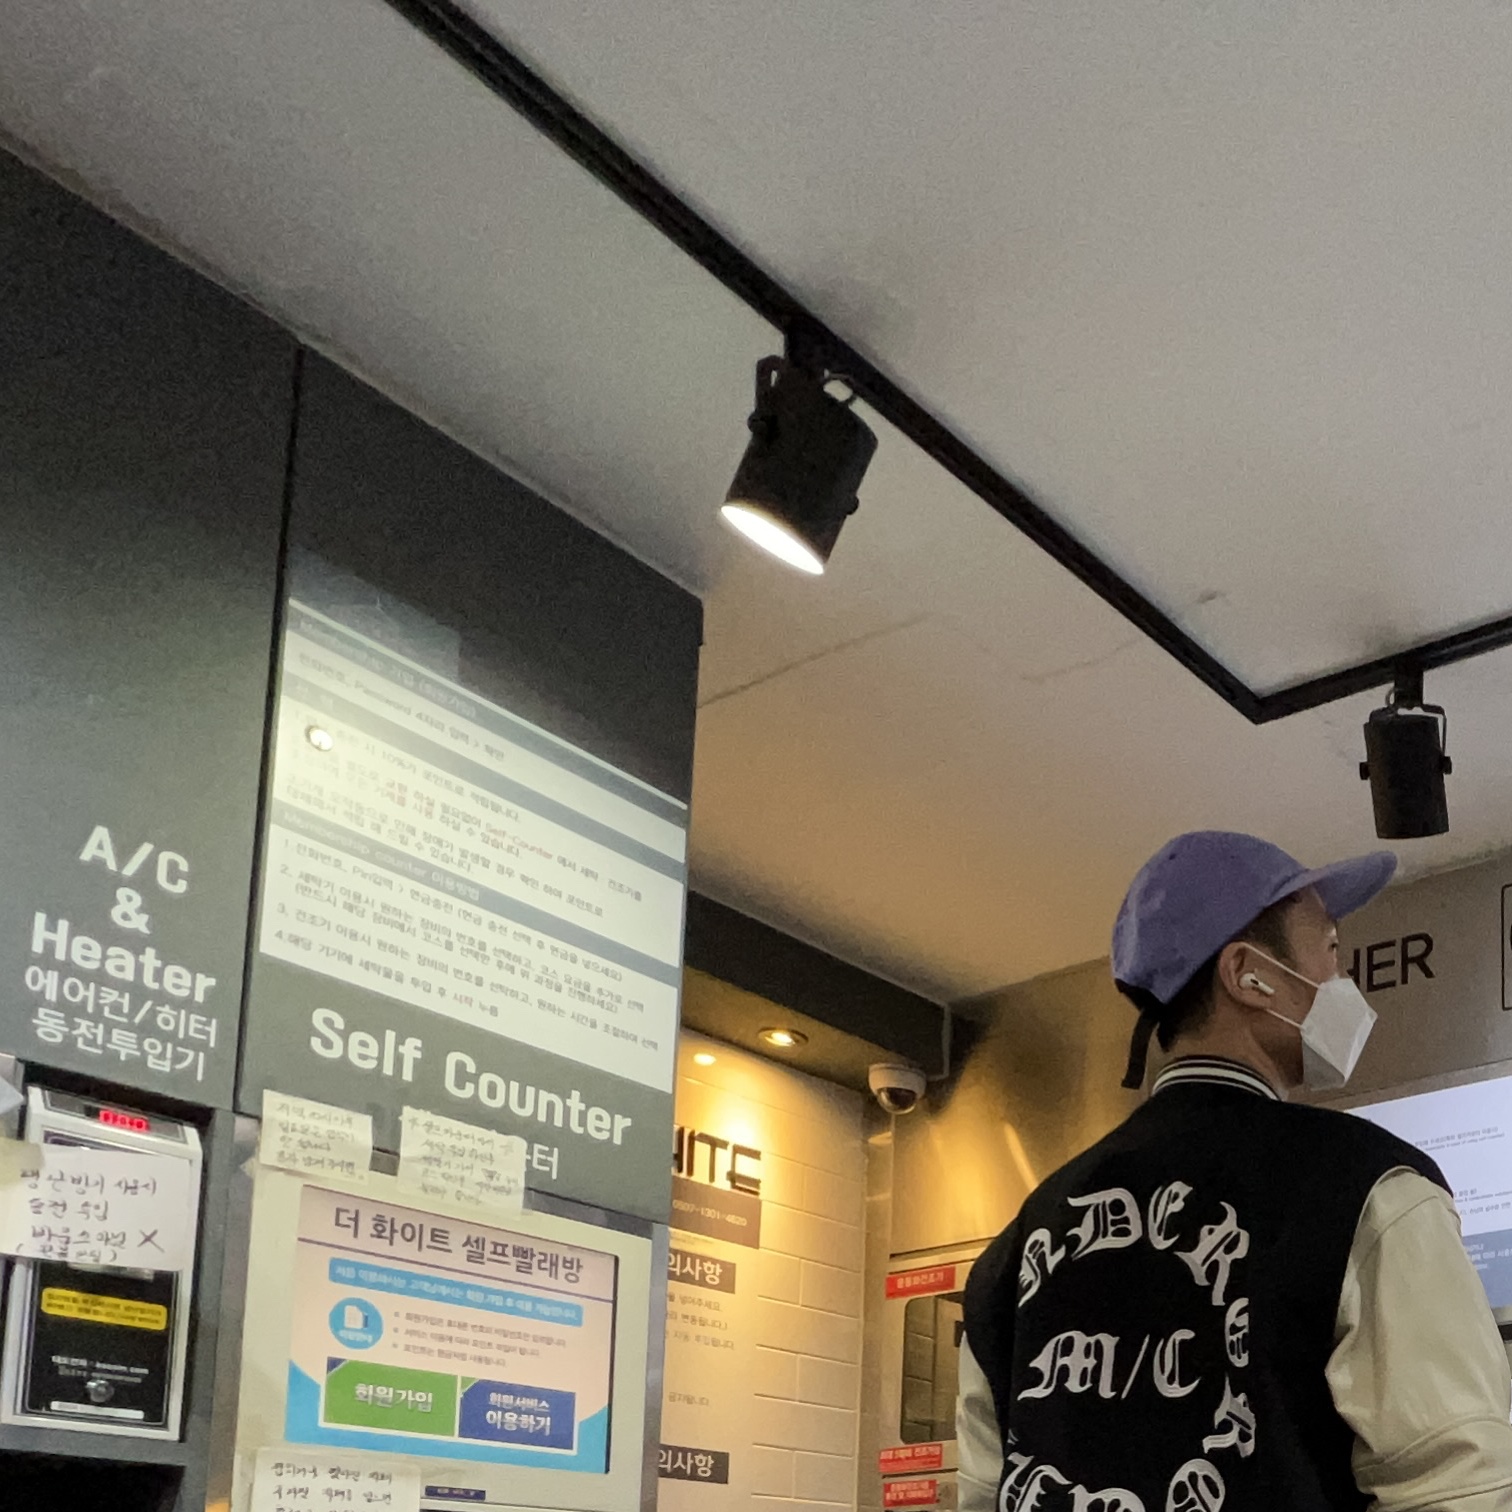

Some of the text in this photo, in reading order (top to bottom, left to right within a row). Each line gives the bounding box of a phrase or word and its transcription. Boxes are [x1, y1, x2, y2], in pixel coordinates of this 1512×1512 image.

[79, 825, 189, 893] A/C
[110, 887, 151, 934] &
[31, 911, 217, 1003] Heater
[25, 965, 217, 1048] 에어컨/히터
[32, 1007, 205, 1082] 동전투입기
[310, 1006, 633, 1146] Self Counter
[334, 1206, 583, 1285] 더 화이트 셀프빨래방
[355, 1382, 434, 1413] 회원가입
[1017, 1329, 1200, 1400] M/C
[485, 1409, 551, 1436] 이용하기
[488, 1392, 550, 1413] 회원서비스
